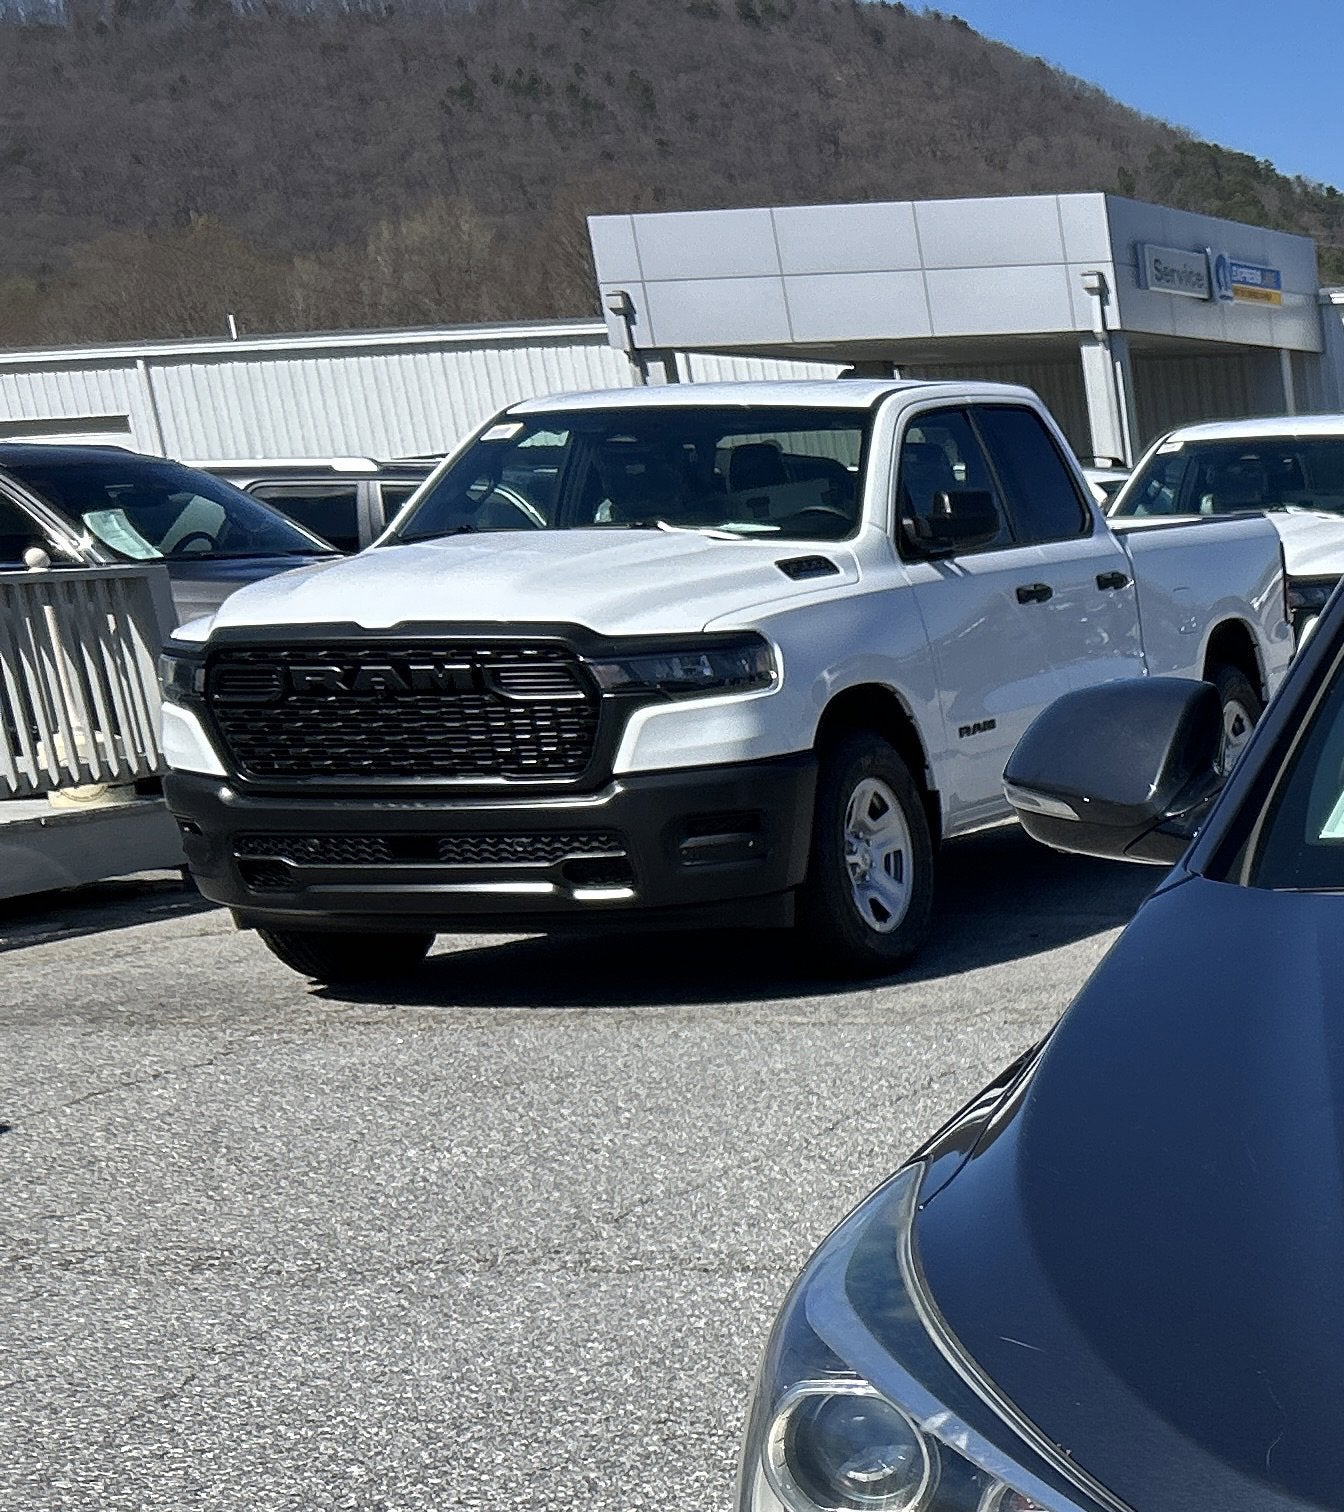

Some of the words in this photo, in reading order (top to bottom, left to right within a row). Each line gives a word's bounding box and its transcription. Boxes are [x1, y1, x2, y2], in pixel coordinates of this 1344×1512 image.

[1153, 258, 1205, 288] Service
[289, 664, 474, 690] RAM
[958, 719, 996, 738] RAM
